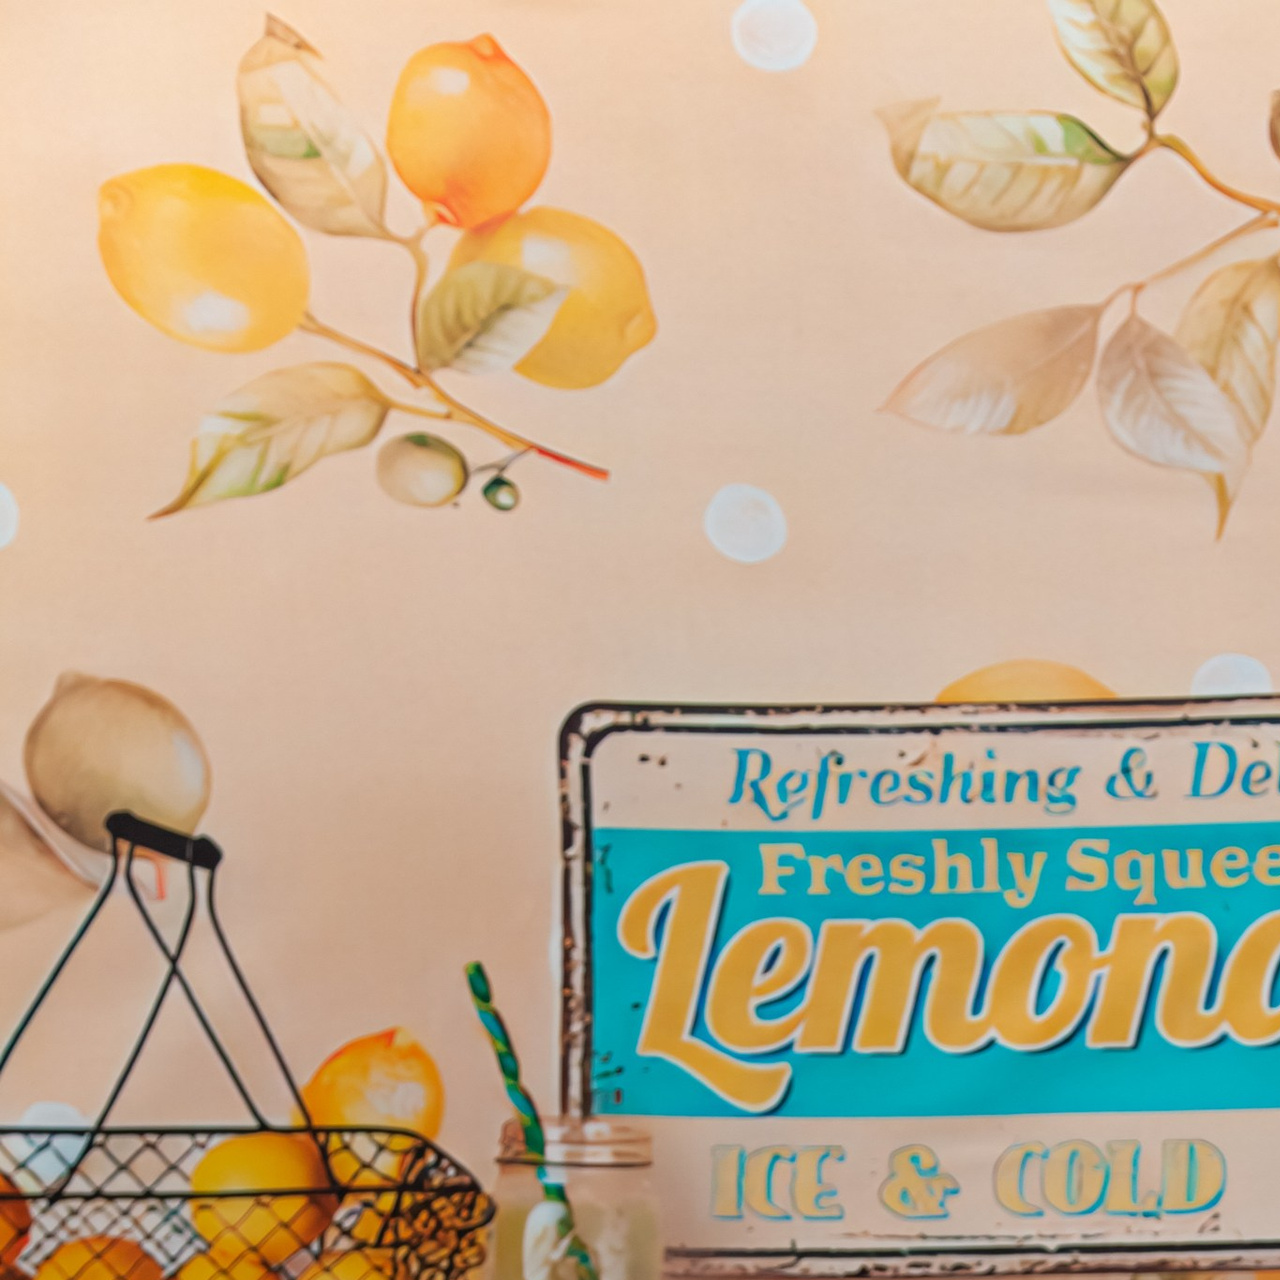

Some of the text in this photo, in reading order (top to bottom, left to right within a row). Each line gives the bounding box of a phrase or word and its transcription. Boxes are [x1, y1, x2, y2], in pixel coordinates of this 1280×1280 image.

[730, 747, 1081, 821] Refreshing
[1105, 748, 1157, 799] &
[758, 838, 1046, 909] Freshly
[711, 1138, 1227, 1220] ICE & COLD
